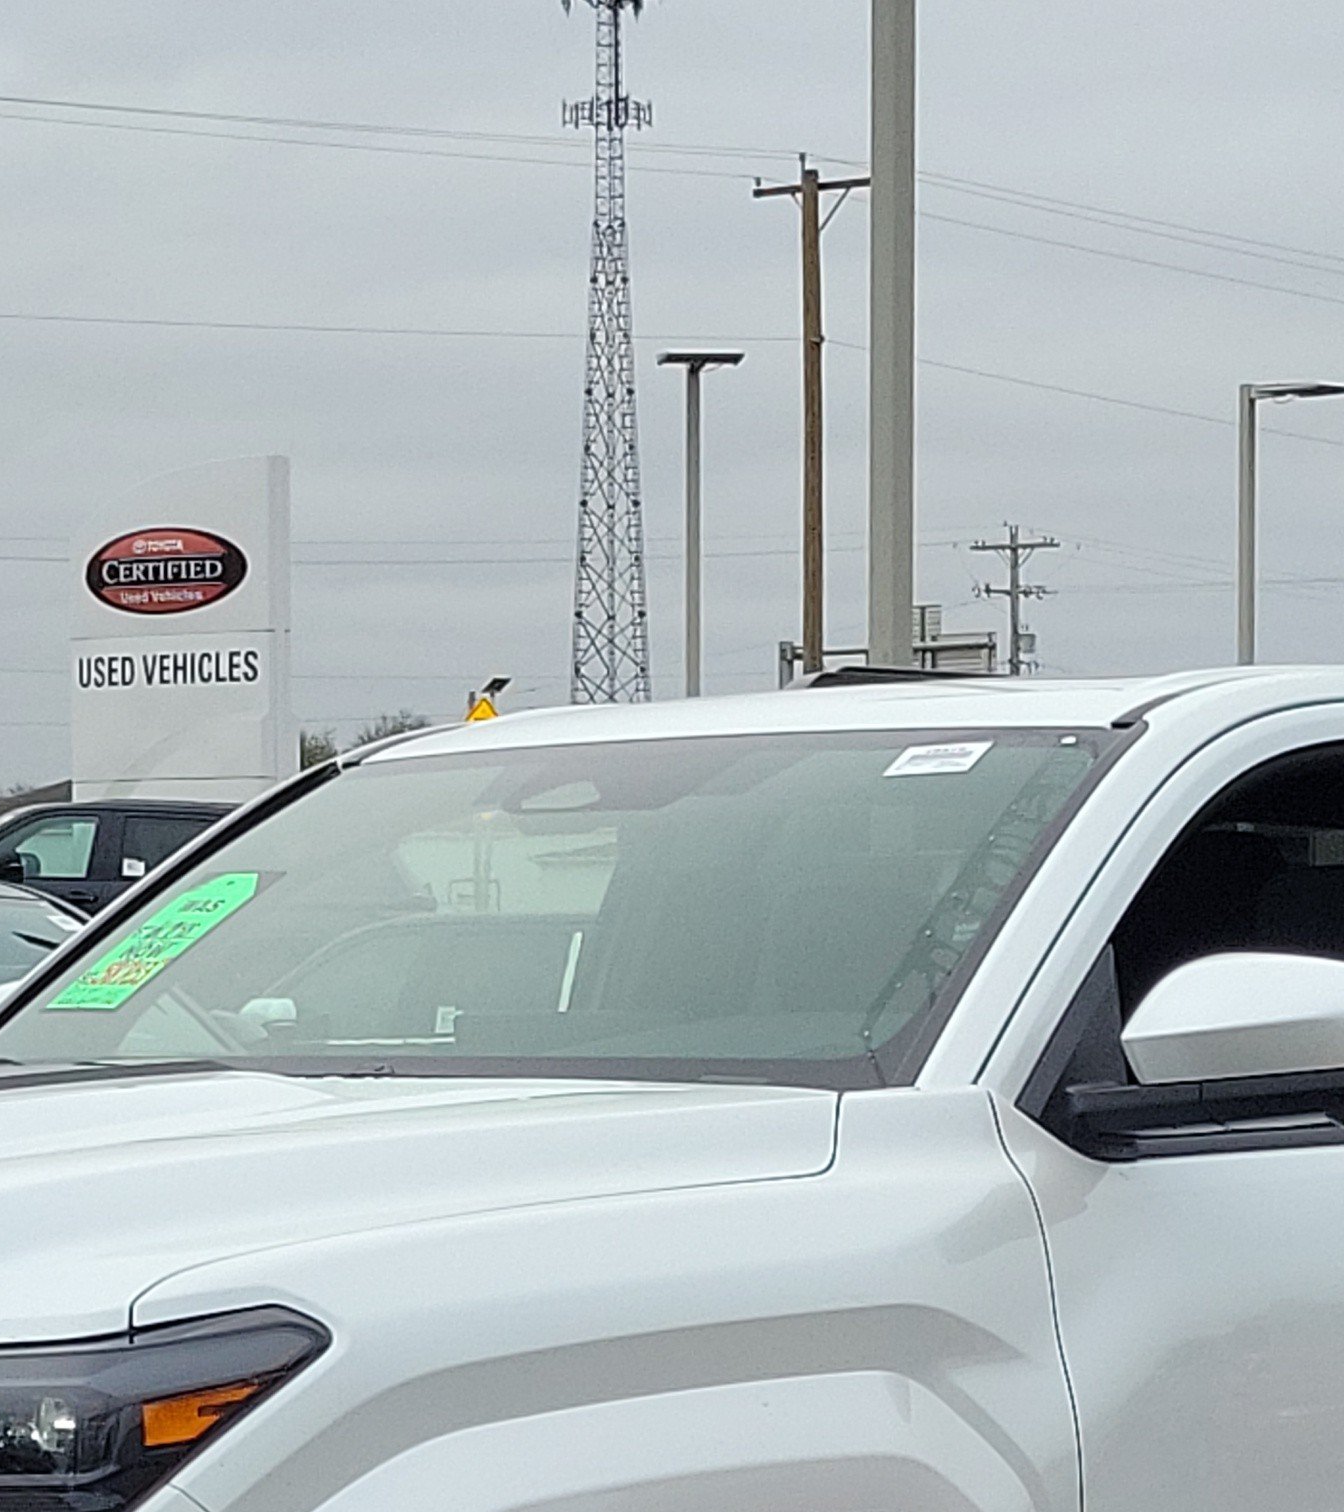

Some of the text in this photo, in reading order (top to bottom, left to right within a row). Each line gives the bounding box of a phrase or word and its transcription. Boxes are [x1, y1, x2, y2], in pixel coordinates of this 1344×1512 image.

[102, 559, 223, 584] CERTIFIED
[120, 589, 203, 604] Used Vehicles
[78, 651, 259, 688] USED VEHICLES
